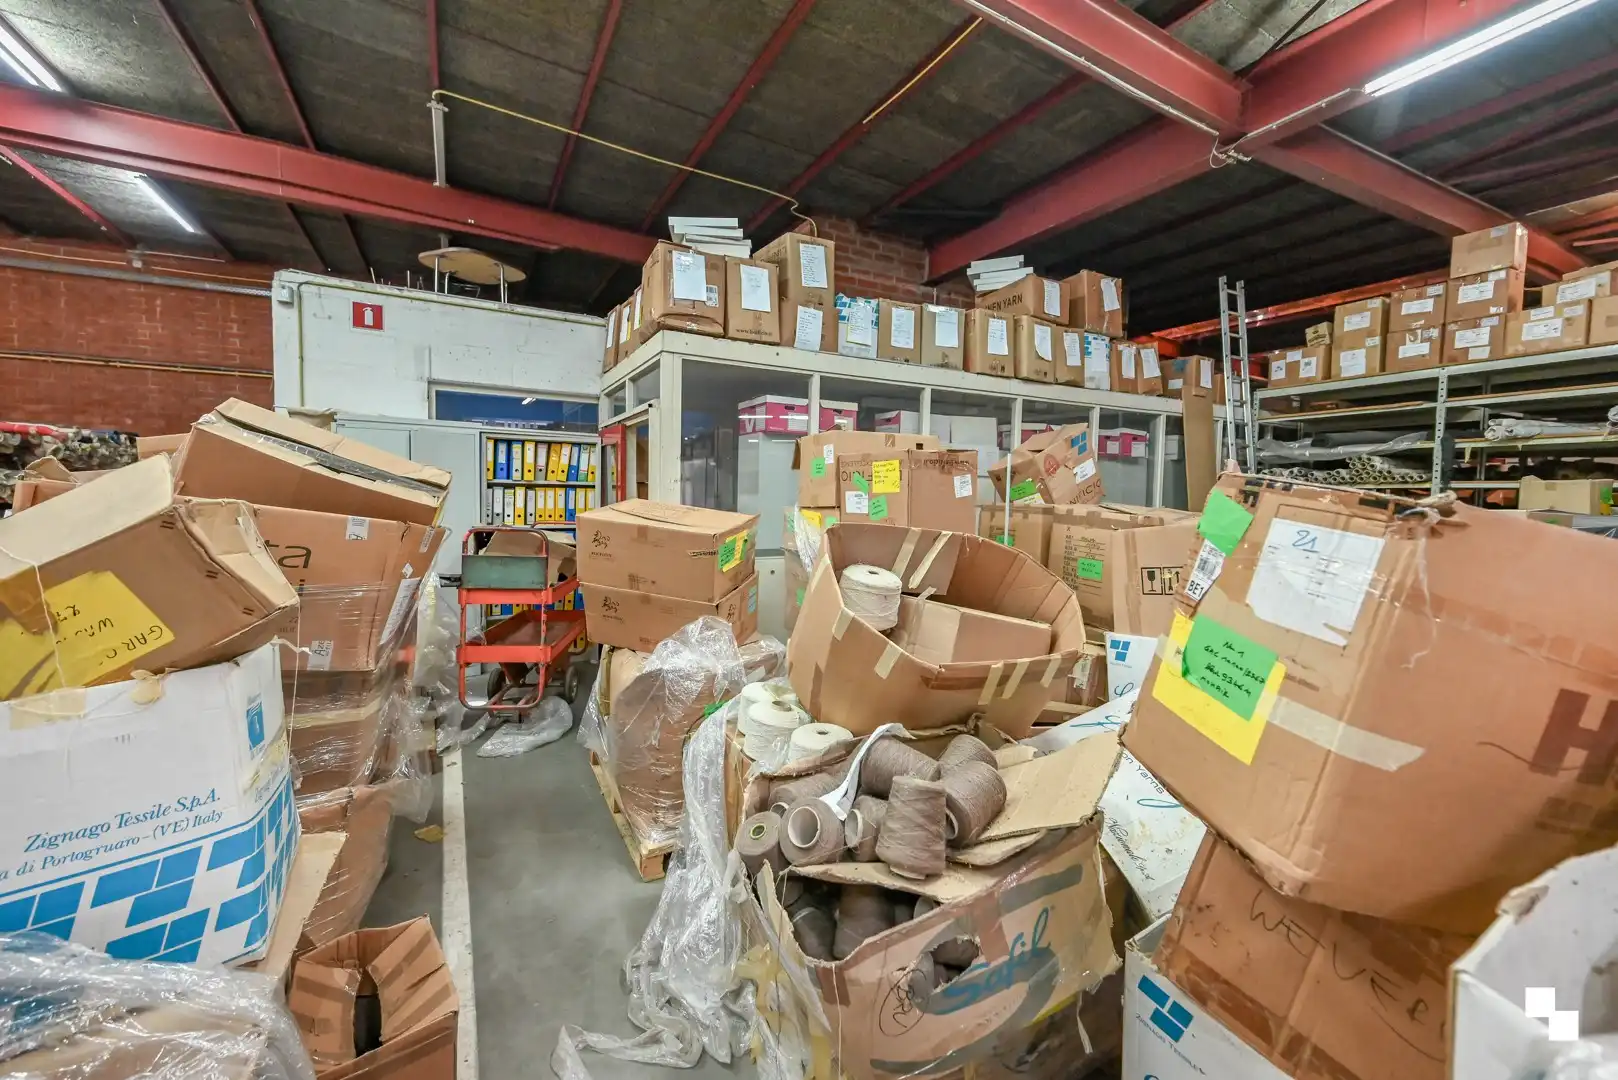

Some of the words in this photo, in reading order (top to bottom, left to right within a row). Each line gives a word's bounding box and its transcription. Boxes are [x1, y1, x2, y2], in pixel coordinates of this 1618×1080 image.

[1003, 292, 1023, 308] YARN
[1136, 763, 1166, 795] Yarns
[16, 859, 36, 877] di
[40, 834, 140, 872] Portogruaro
[152, 815, 188, 842] (VE)
[191, 808, 224, 832] Italy
[24, 820, 112, 854] Zignago
[114, 802, 172, 830] Tessile
[174, 788, 221, 815] S.p.A.
